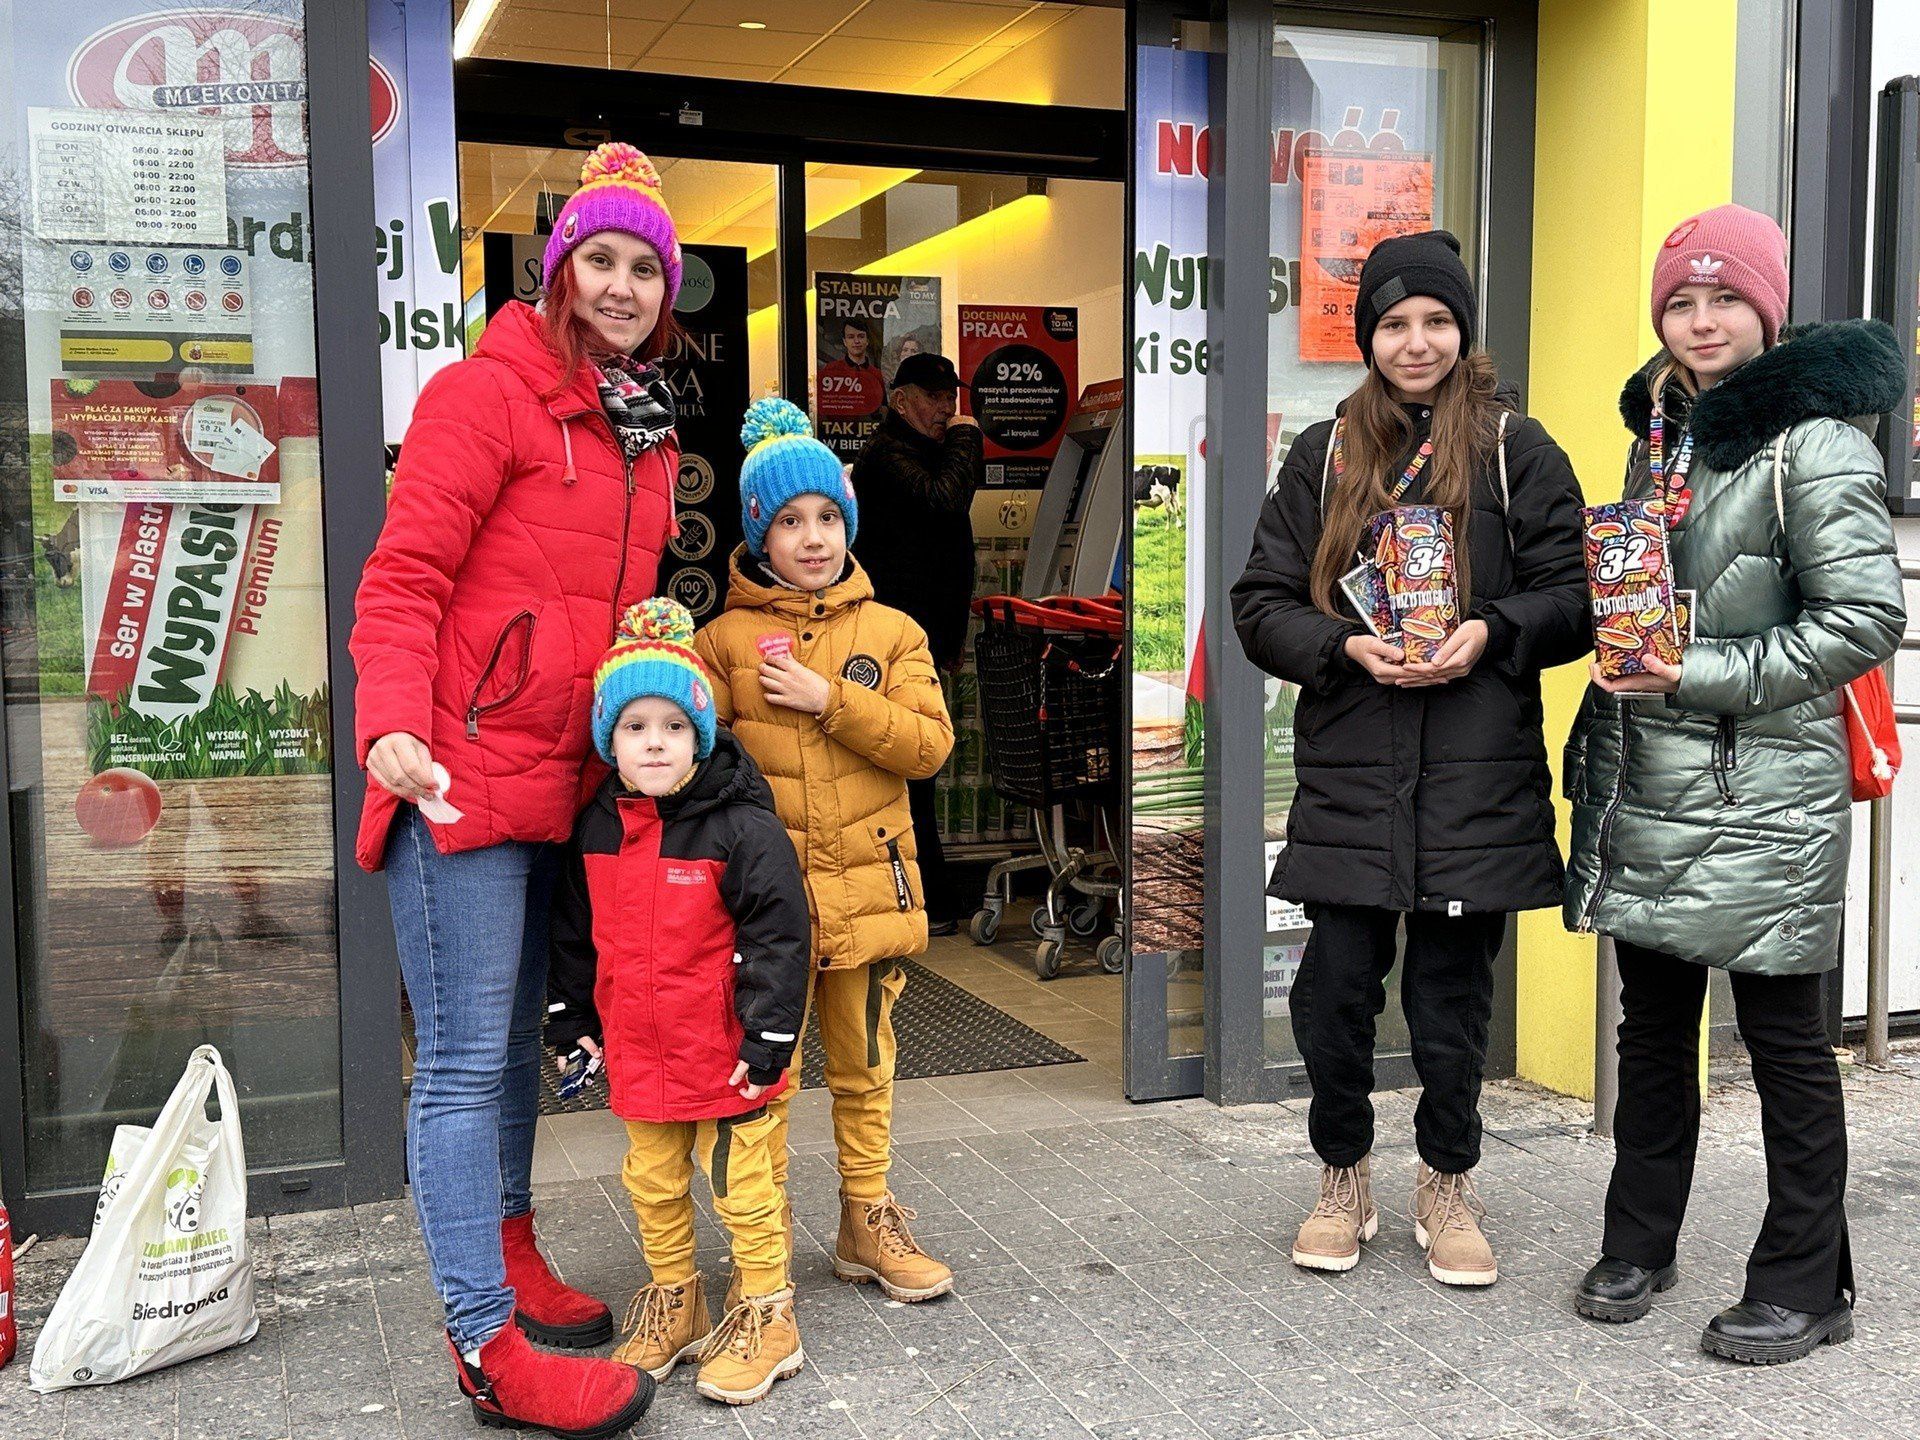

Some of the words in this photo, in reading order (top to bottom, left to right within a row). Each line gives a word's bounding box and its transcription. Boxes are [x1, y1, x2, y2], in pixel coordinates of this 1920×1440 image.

[165, 85, 307, 106] MLEKOVITA
[684, 101, 690, 110] 2
[51, 122, 102, 132] GODZINY
[106, 124, 162, 136] OTWARCIA
[166, 128, 204, 138] SKLEPU
[168, 148, 194, 156] 22:00
[168, 160, 194, 169] 22:00
[168, 173, 195, 181] 22:00
[169, 186, 196, 194] 22:00
[170, 198, 196, 206] 22:00
[170, 210, 197, 218] 22:00
[171, 222, 197, 230] 20:00
[820, 280, 902, 298] STABILNA
[910, 292, 920, 300] TO
[820, 298, 901, 319] PRACA
[1322, 304, 1338, 316] 50
[1346, 304, 1355, 316] 3
[962, 310, 1028, 322] DOCENIANA
[962, 322, 1028, 338] PRACA
[996, 362, 1043, 382] 92%
[822, 376, 862, 392] 97%
[978, 386, 1008, 394] naszych
[1010, 386, 1060, 394] pracowników
[984, 396, 999, 404] jest
[1000, 396, 1054, 405] zadowolonych
[85, 404, 108, 413] PŁAĆ
[70, 414, 122, 422] WYPŁACAJ
[151, 416, 178, 424] KASIE
[822, 422, 854, 434] TAK
[823, 438, 837, 450] W
[88, 486, 108, 495] VISA
[1603, 536, 1626, 546] 2024
[1405, 538, 1447, 580] 32
[1596, 534, 1651, 584] 32
[234, 518, 283, 636] Premium
[122, 583, 147, 609] w
[110, 614, 140, 659] Ser
[110, 734, 128, 744] BEZ
[206, 730, 248, 740] WYSOKA
[268, 728, 310, 739] WYSOKA
[110, 752, 186, 764] KONSERWUJĄCYCH
[209, 750, 246, 760] WAPNIA
[274, 748, 306, 758] BIAŁKA
[893, 860, 904, 896] FASHION
[1264, 970, 1285, 982] BIEKT
[132, 1286, 229, 1321] Biedronka
